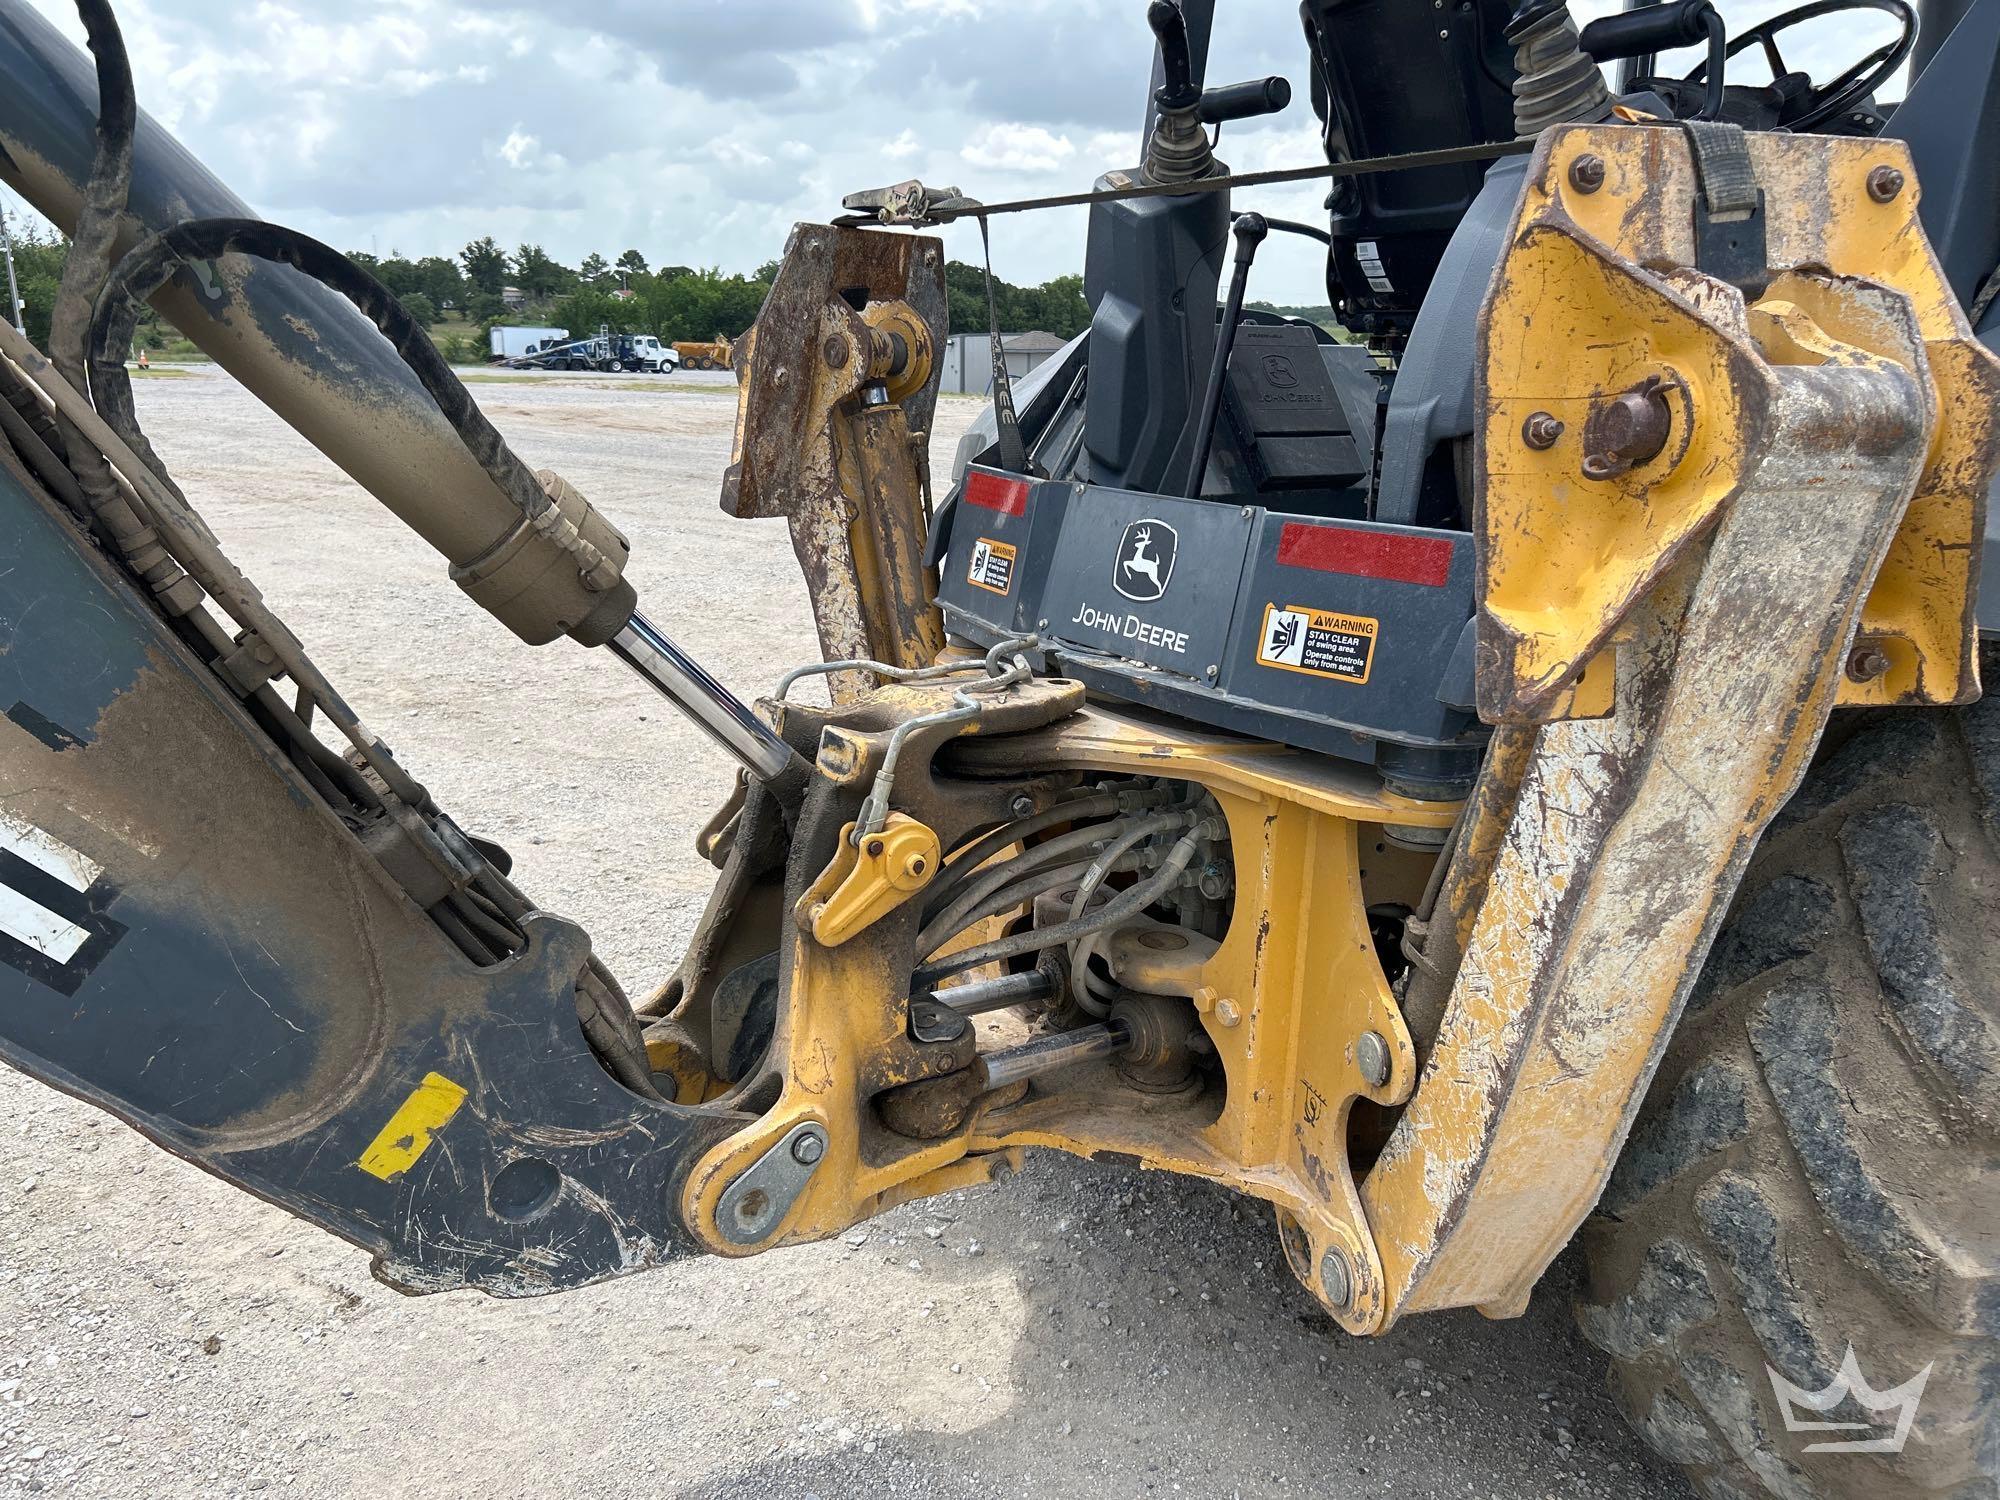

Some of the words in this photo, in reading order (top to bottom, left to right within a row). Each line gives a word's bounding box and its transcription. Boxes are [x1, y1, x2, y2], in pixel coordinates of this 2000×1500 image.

[1288, 392, 1323, 402] DEERE
[1072, 602, 1121, 634] JOHN
[1123, 615, 1190, 654] DEERE
[1324, 616, 1373, 634] WARNING
[1309, 631, 1330, 641] STAY
[1331, 634, 1359, 646] CLEAR
[1316, 641, 1337, 652] swing
[1338, 645, 1356, 654] area.
[1304, 658, 1320, 668] only
[1320, 660, 1337, 669] from
[1338, 664, 1356, 673] seat.
[1305, 650, 1333, 661] Operate
[1334, 655, 1364, 667] controls
